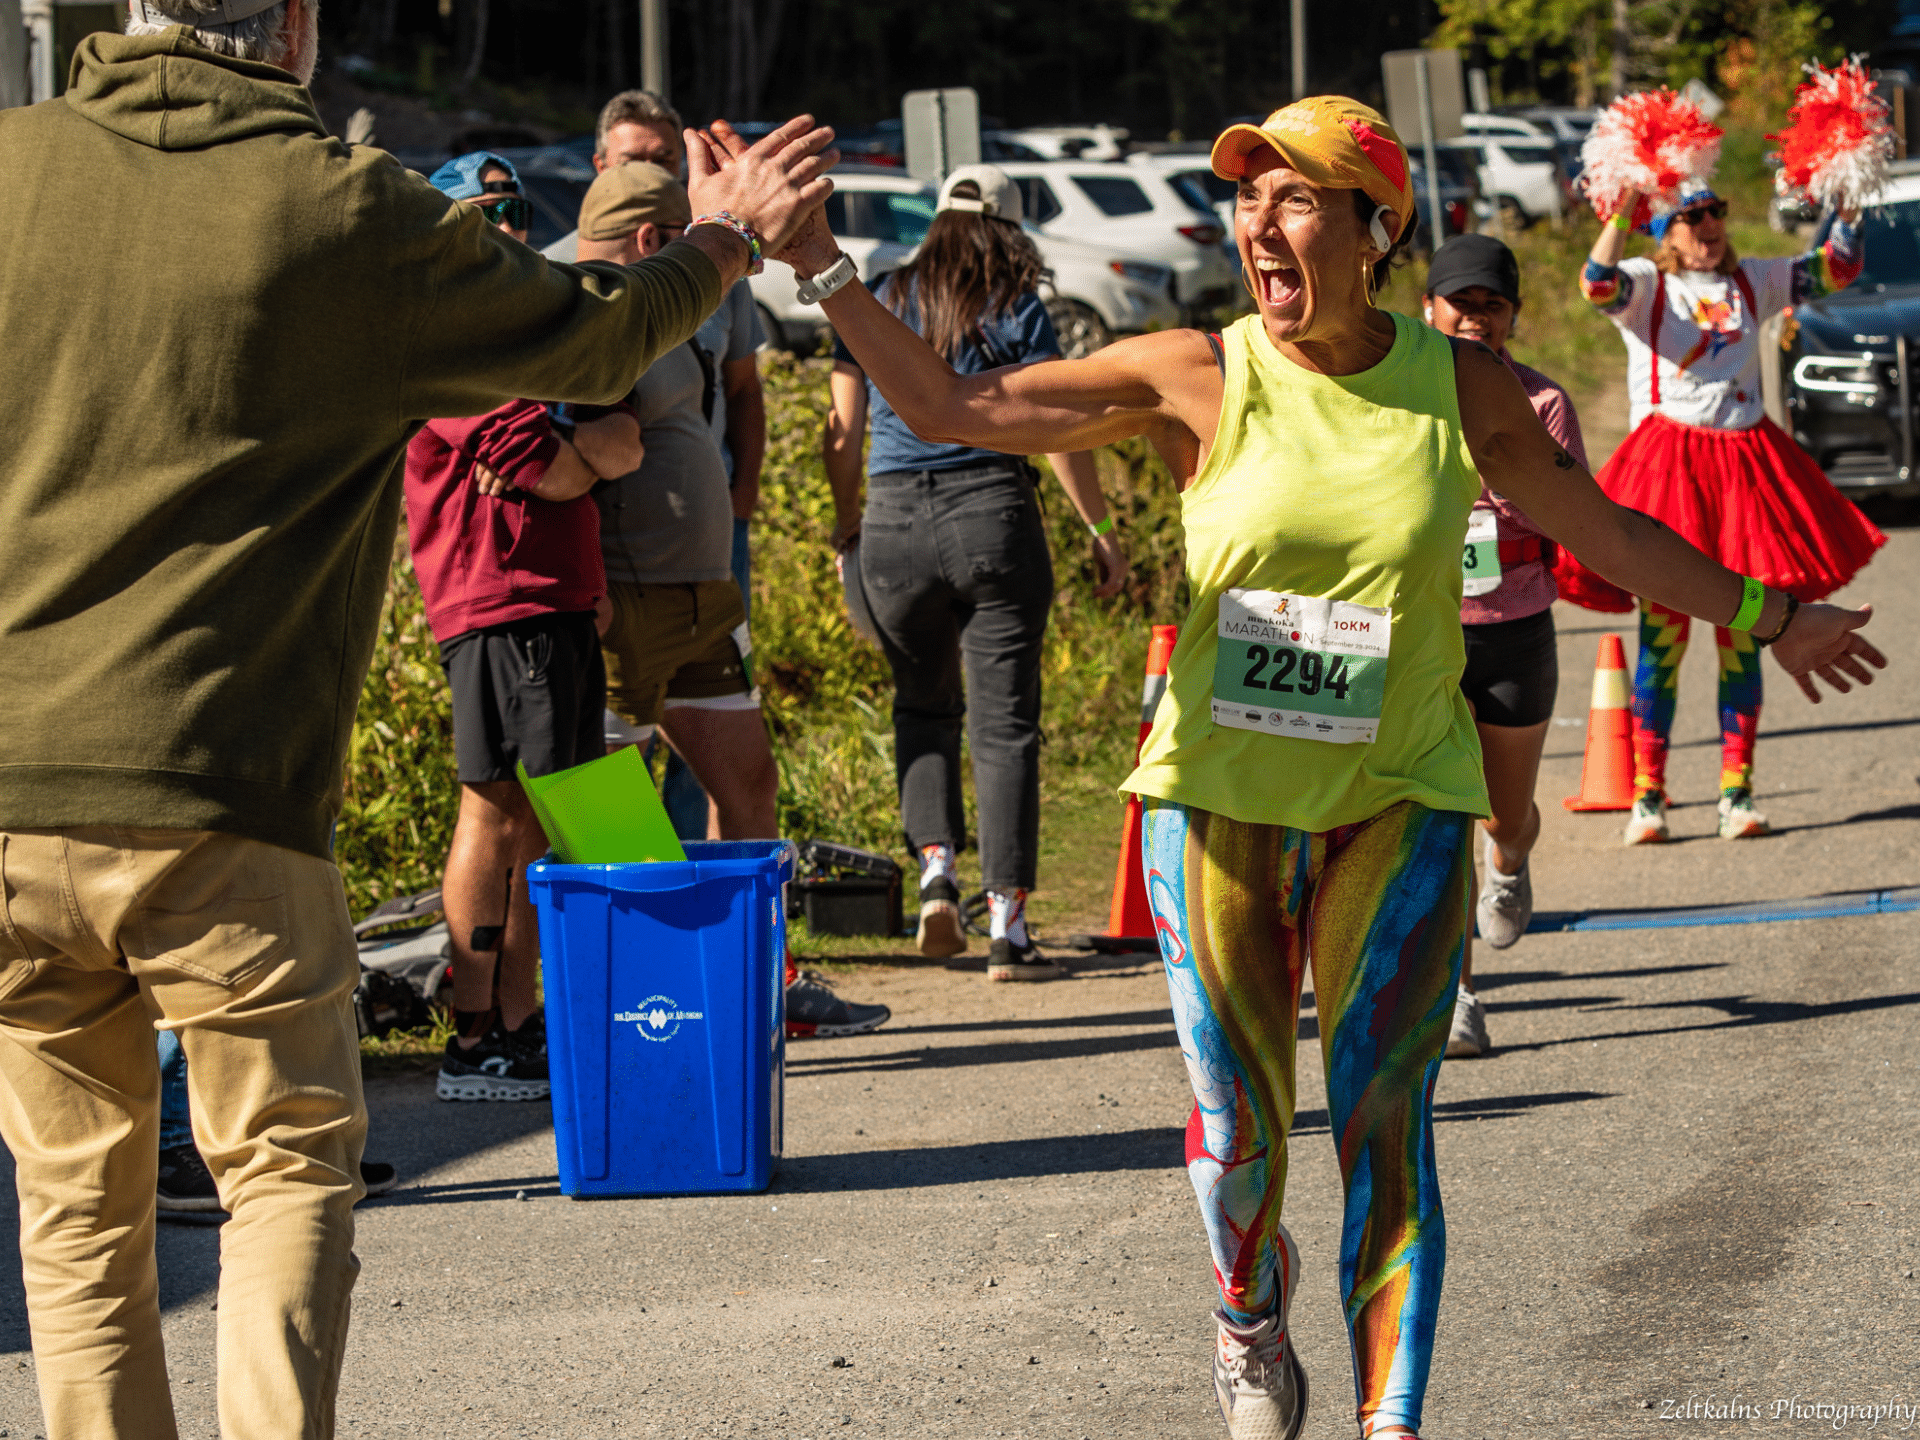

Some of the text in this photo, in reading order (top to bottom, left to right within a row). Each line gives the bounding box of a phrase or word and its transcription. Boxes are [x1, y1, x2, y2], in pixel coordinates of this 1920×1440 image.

[1464, 543, 1479, 569] 3
[1247, 615, 1295, 628] muskoka
[1334, 620, 1371, 633] 10KM
[1225, 620, 1315, 645] MARATHON
[1320, 639, 1354, 649] September
[1243, 644, 1350, 700] 2294
